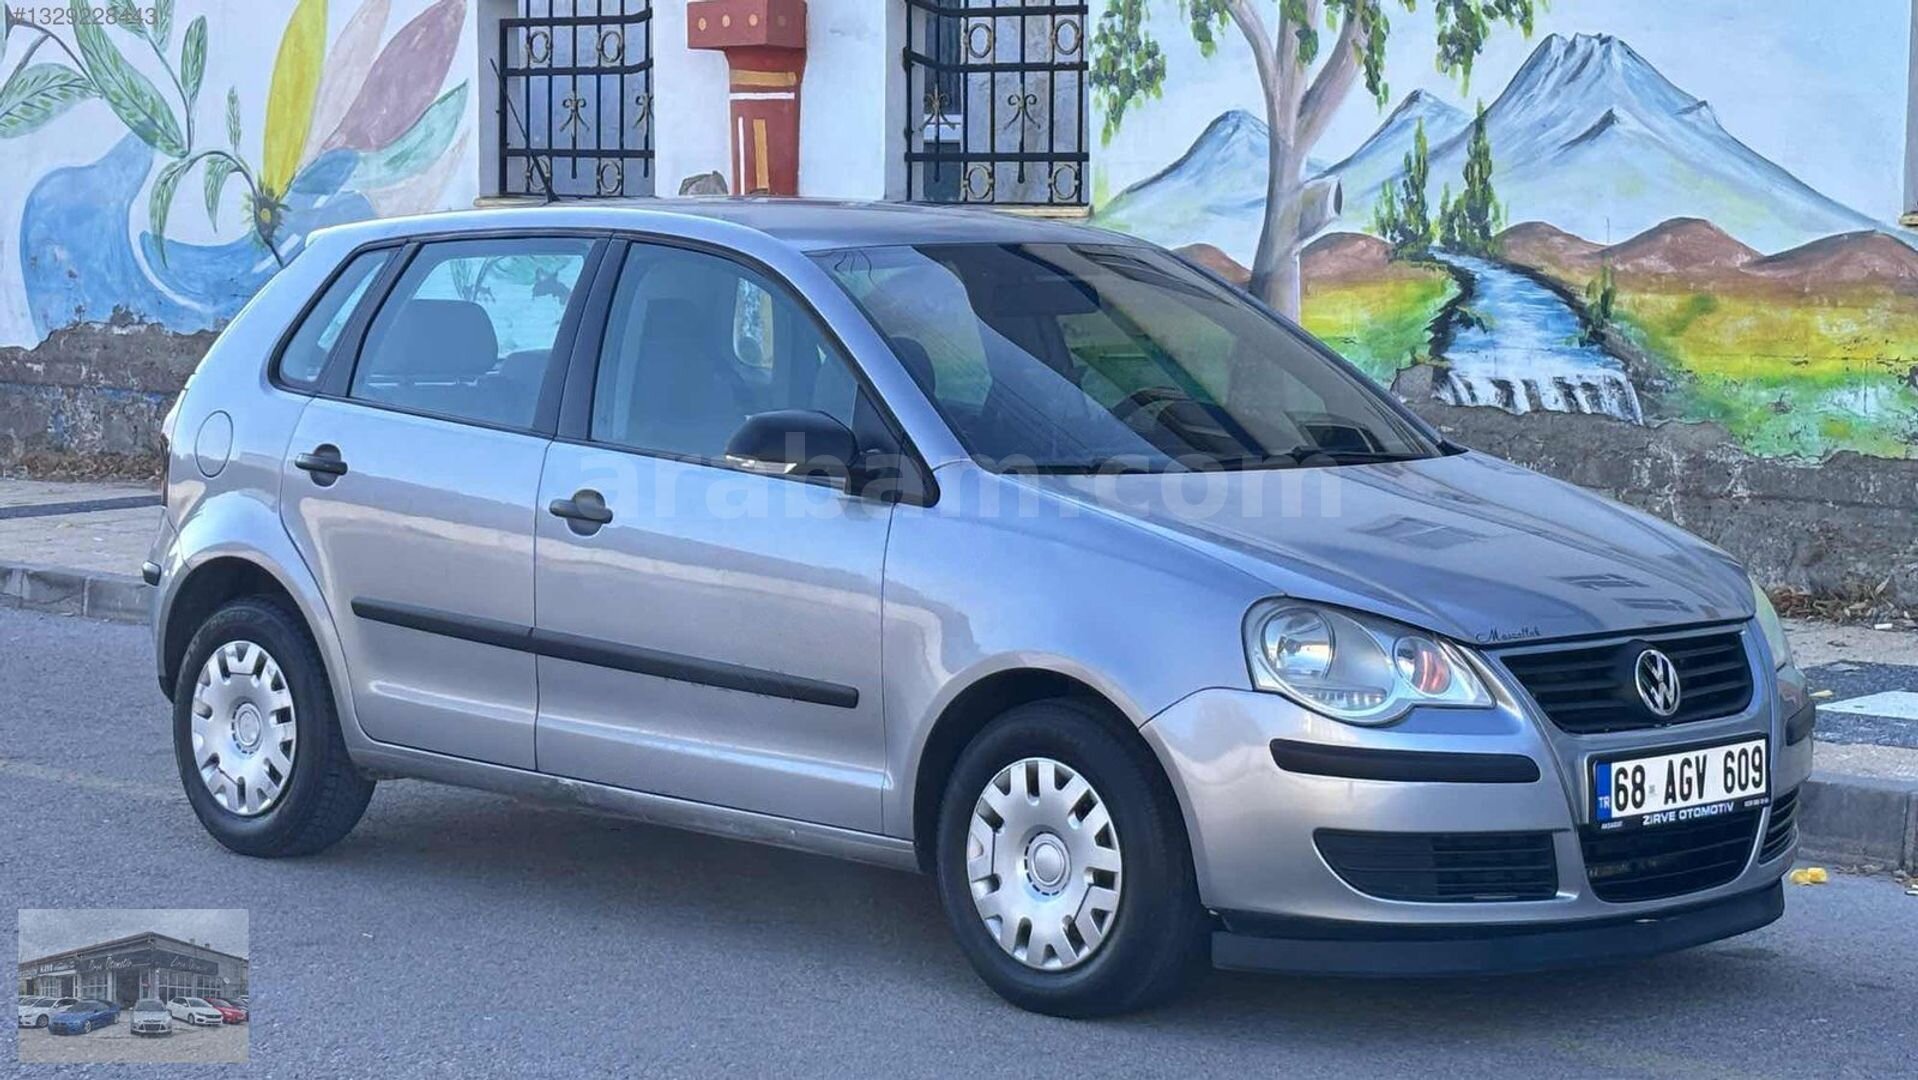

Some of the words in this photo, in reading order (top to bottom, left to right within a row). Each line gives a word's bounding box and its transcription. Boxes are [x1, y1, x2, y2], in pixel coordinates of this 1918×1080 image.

[1614, 764, 1646, 811] 68
[1664, 754, 1707, 805] AGV
[1723, 745, 1764, 794] 609
[1598, 796, 1610, 809] TR
